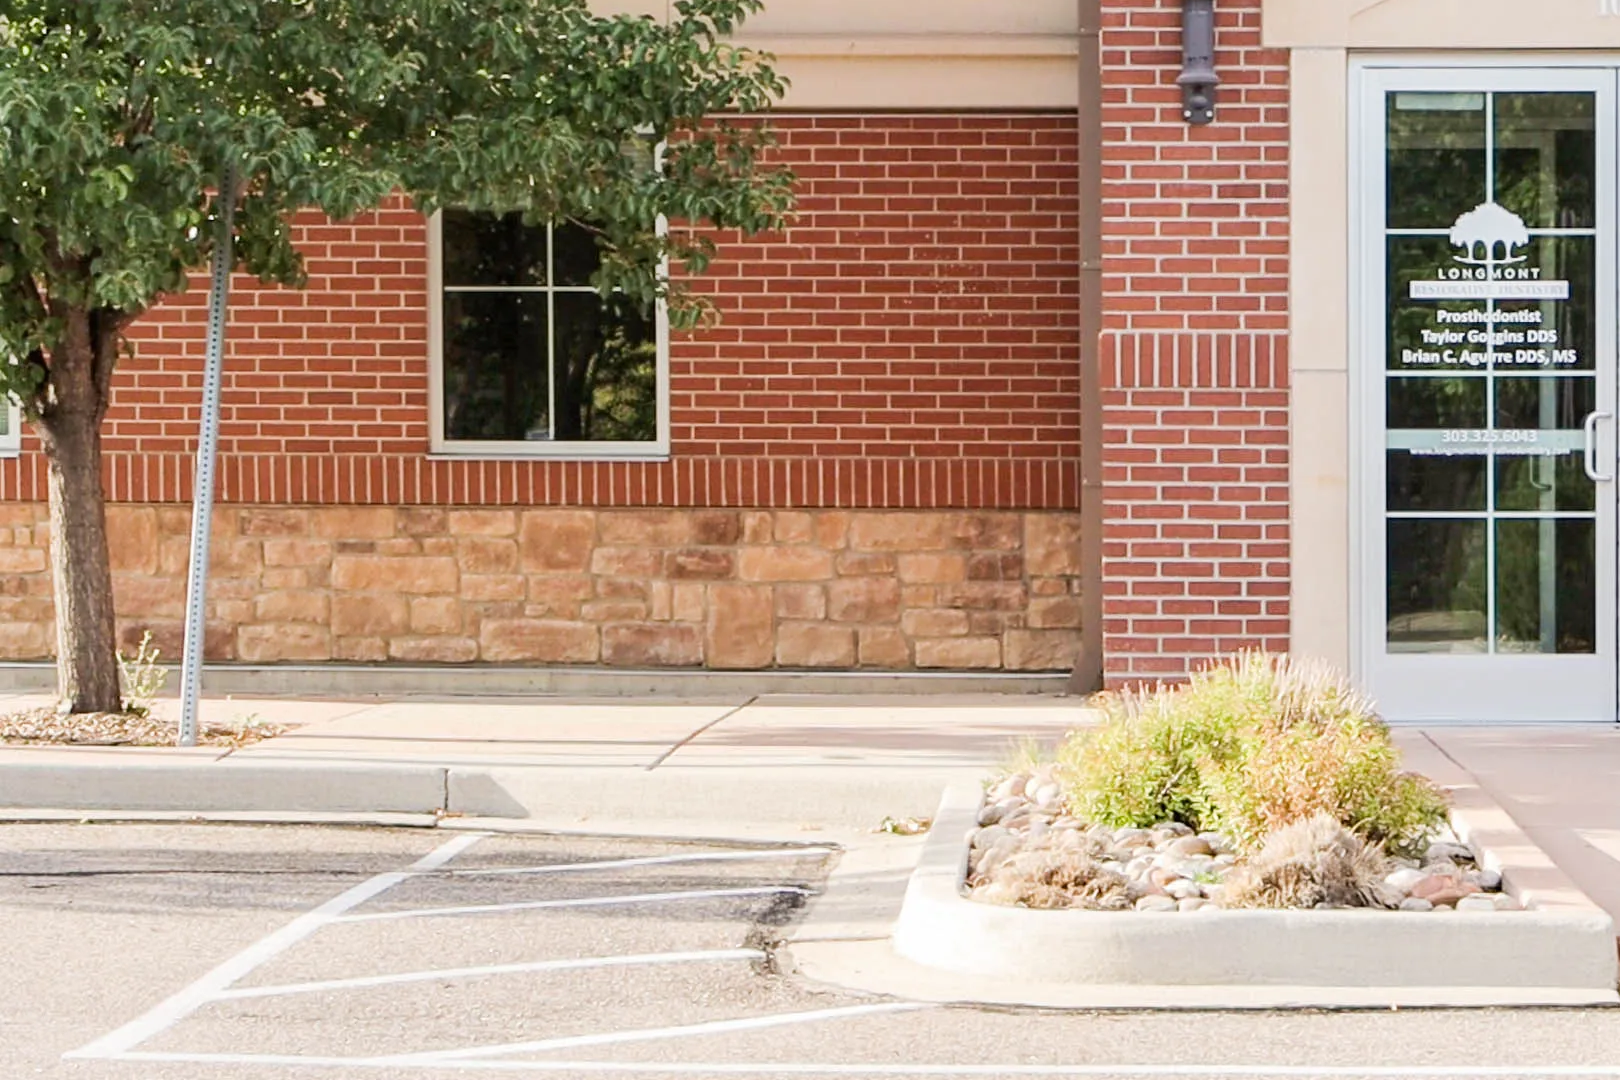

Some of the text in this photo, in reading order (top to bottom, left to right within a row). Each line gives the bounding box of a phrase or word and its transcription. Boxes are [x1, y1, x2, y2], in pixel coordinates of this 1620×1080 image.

[1438, 268, 1540, 279] LONGMONT
[1436, 309, 1542, 323] Prosthodontist
[1421, 329, 1465, 345] Taylor
[1527, 329, 1557, 343] DDS
[1402, 349, 1577, 365] Brian C. Agurre DDS, MS
